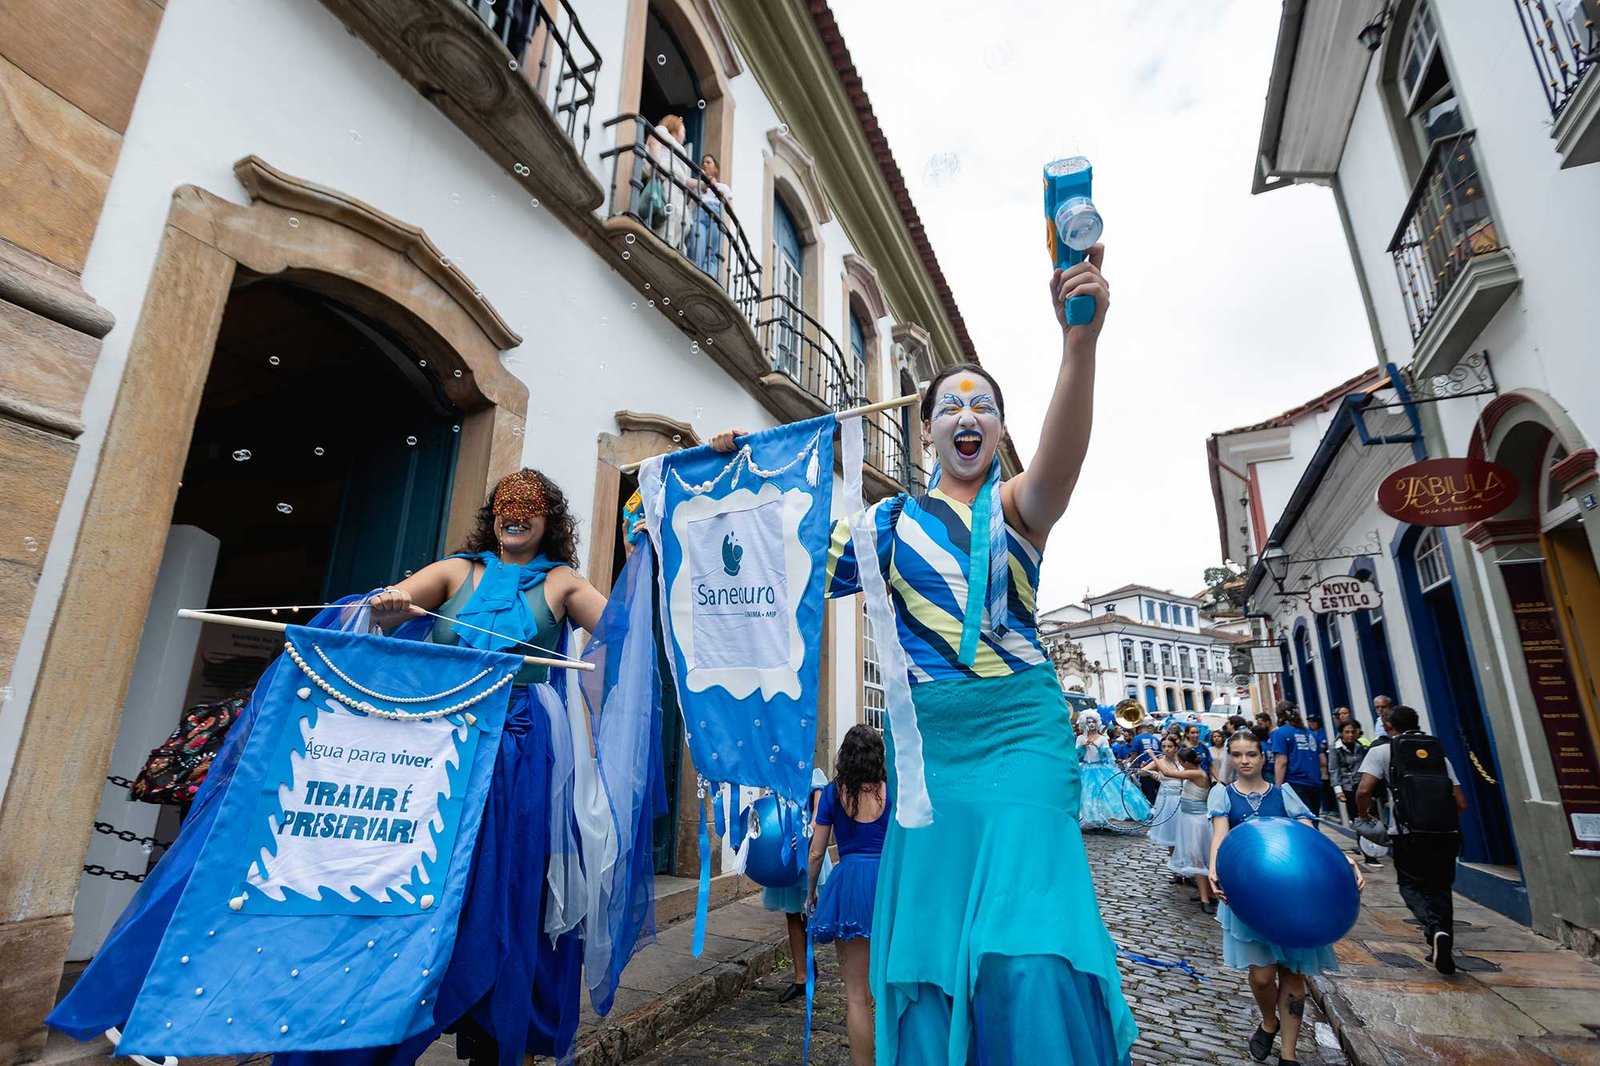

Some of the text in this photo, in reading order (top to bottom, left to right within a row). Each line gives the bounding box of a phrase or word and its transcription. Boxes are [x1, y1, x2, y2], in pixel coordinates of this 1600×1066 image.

[1320, 594, 1369, 609] ESTILO
[1323, 582, 1360, 595] NOVO
[305, 737, 434, 769] Água para viver.
[304, 780, 413, 813] TRATAR É
[277, 810, 418, 844] PRESERVAR!
